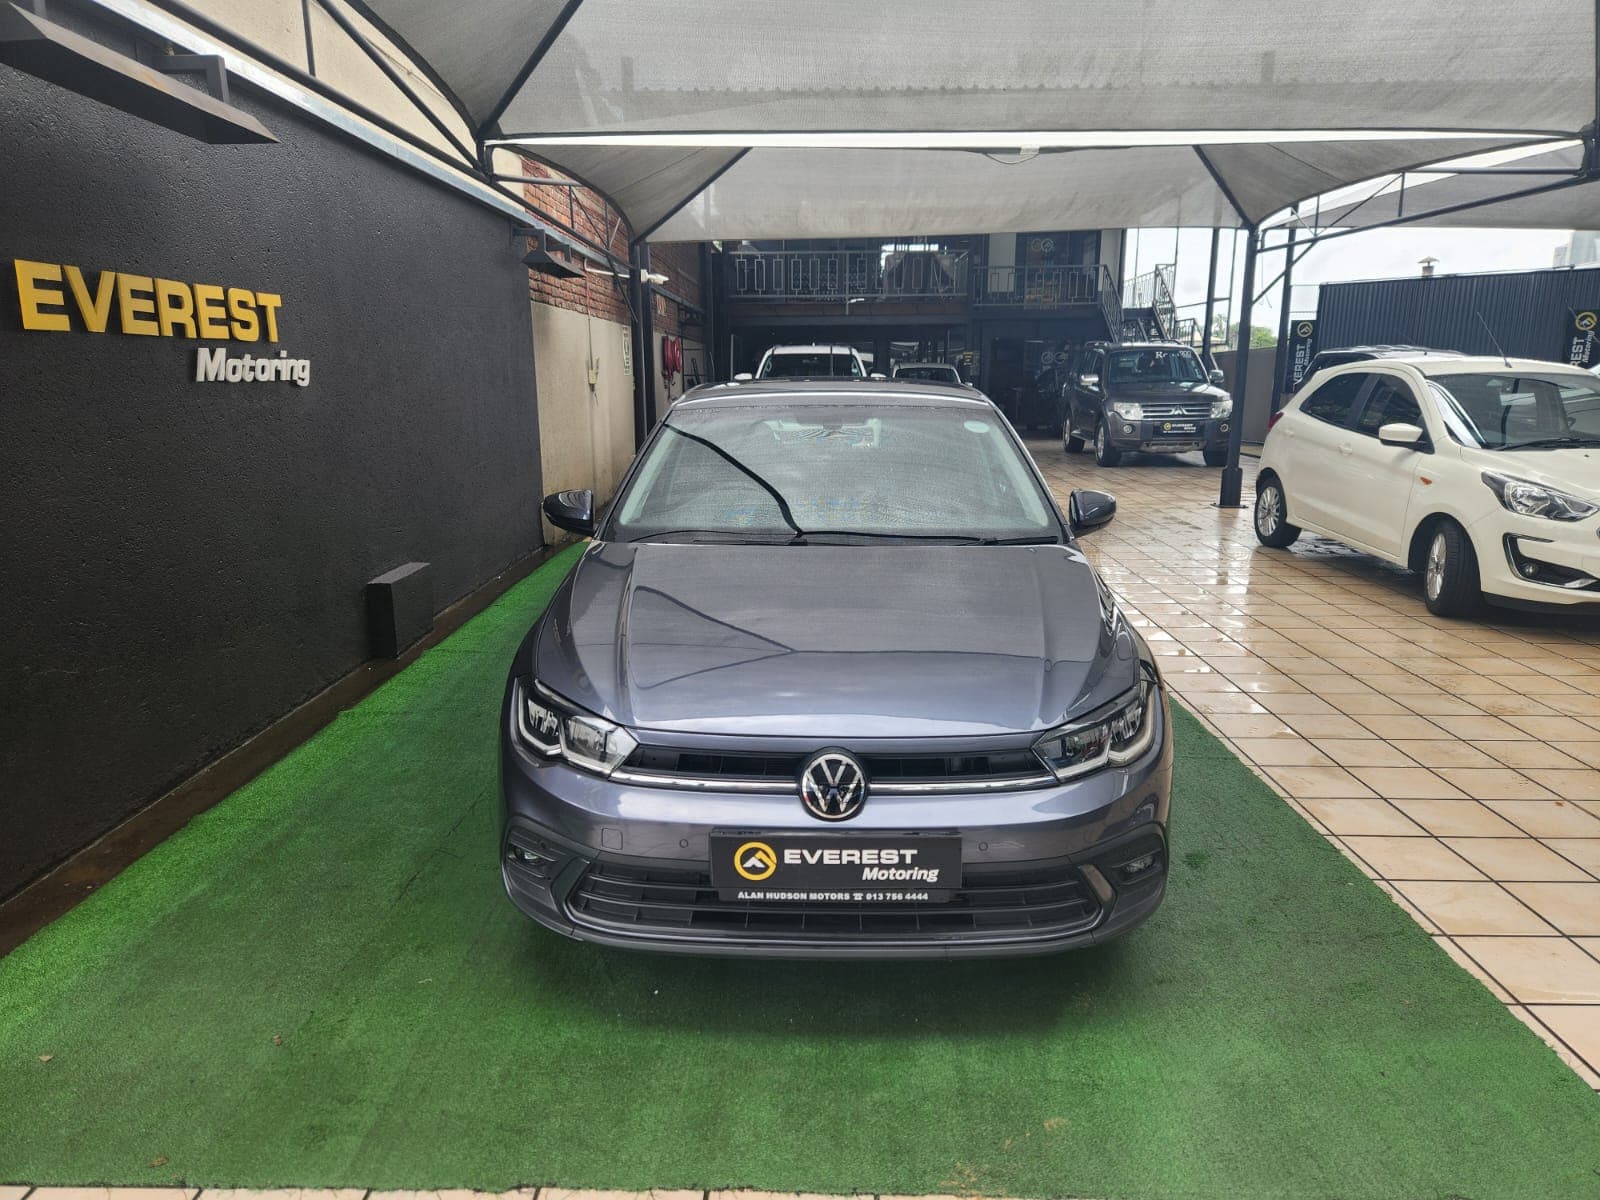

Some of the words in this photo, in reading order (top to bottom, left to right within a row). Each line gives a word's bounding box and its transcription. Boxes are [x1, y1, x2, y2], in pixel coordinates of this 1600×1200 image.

[14, 258, 282, 343] EVEREST
[196, 347, 310, 387] Motoring
[783, 849, 918, 865] EVEREST
[861, 866, 939, 883] Motoring
[737, 891, 764, 900] ALAN
[766, 892, 808, 901] HUDSON
[809, 892, 850, 901] MOTORS
[866, 892, 884, 901] 013
[886, 892, 903, 901] 756
[905, 892, 929, 901] 4444
